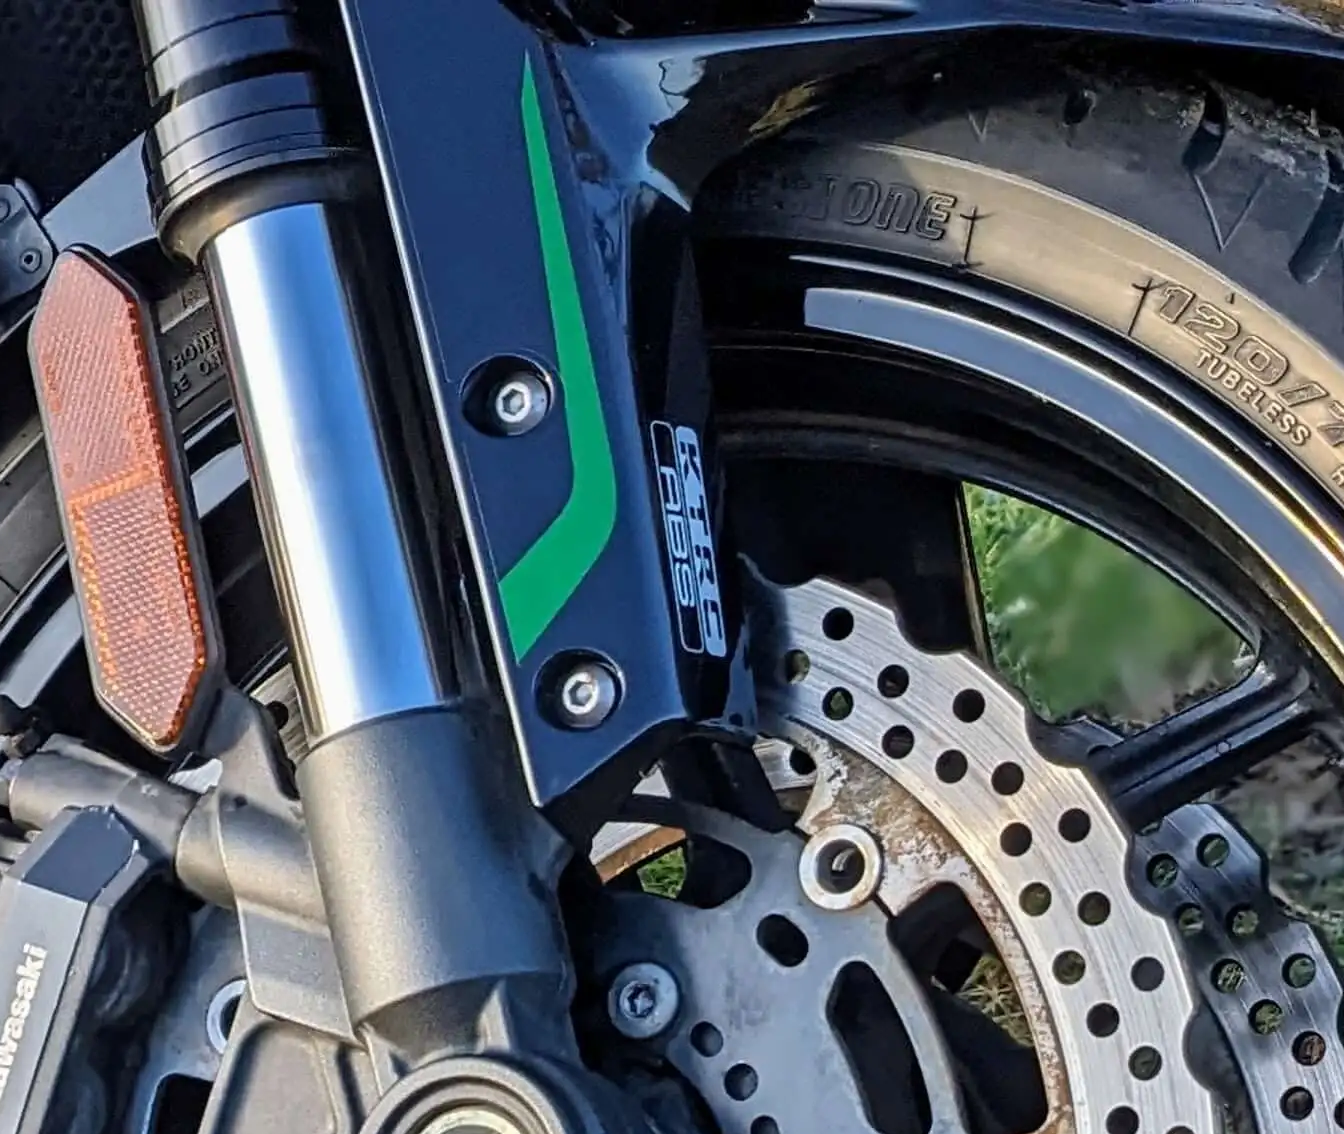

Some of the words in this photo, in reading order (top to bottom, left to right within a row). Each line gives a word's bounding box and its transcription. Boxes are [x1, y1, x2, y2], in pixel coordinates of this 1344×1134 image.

[1195, 347, 1311, 446] TUBELESS
[660, 465, 696, 608] ABS
[679, 438, 724, 643] KTRC
